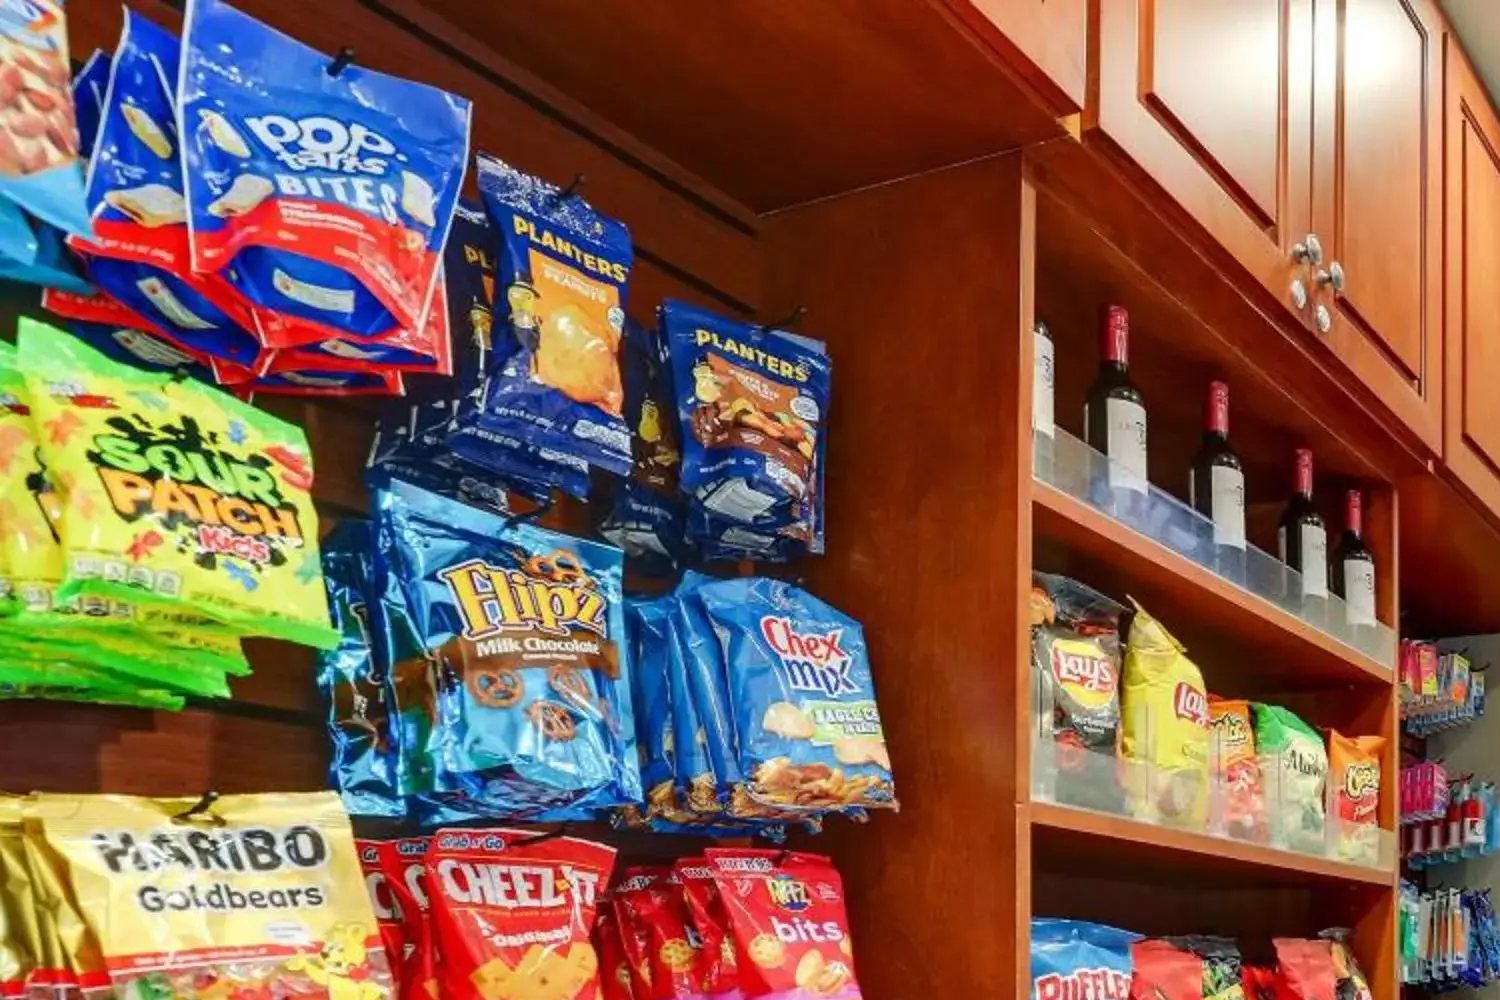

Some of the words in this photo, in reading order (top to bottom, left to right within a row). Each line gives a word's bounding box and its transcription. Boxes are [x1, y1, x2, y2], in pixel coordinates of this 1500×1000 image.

[274, 173, 399, 226] BITES
[512, 213, 628, 283] PLANTERS
[696, 329, 810, 382] PLANTERS
[94, 433, 281, 507] SOUR
[97, 465, 303, 543] PATCH
[475, 637, 522, 657] Milk
[761, 616, 846, 663] Chex
[1059, 650, 1112, 691] Lay's
[484, 835, 505, 851] Go
[138, 884, 324, 913] Goldbears
[769, 915, 843, 943] bits
